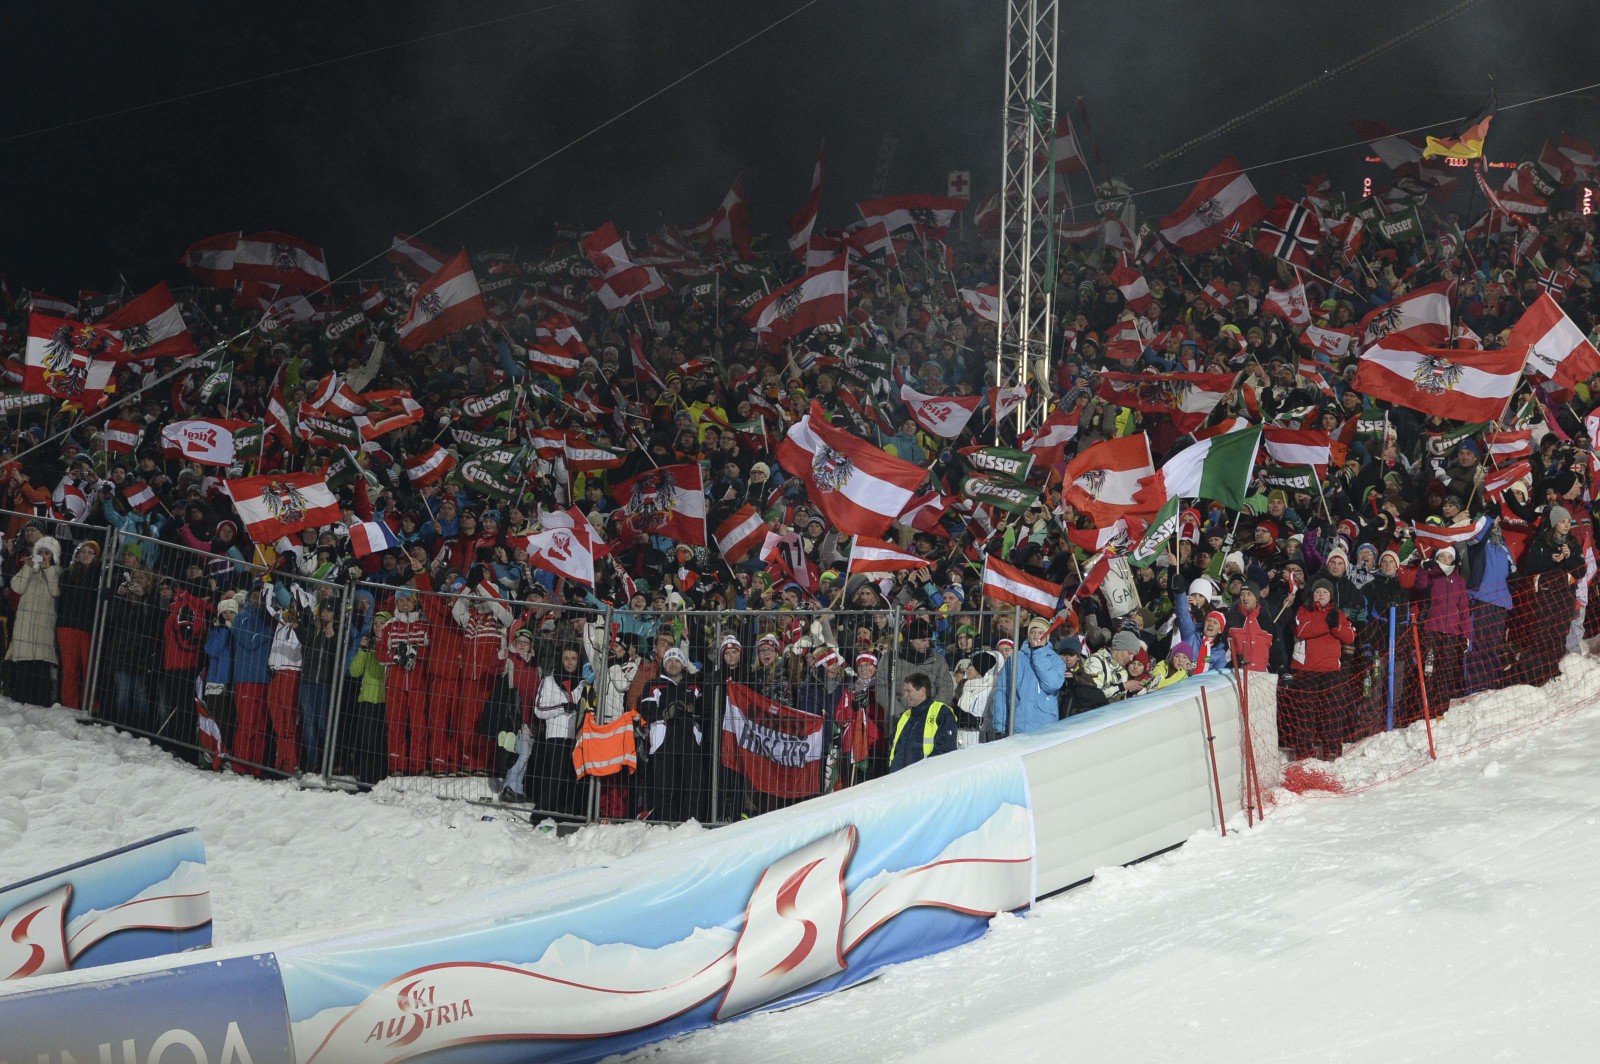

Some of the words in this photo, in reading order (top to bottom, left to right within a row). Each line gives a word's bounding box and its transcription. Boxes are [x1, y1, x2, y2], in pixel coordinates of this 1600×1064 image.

[1378, 218, 1412, 239] Gösser
[325, 311, 365, 340] Gösser
[462, 388, 511, 418] Gösser
[964, 477, 1029, 504] Gösser
